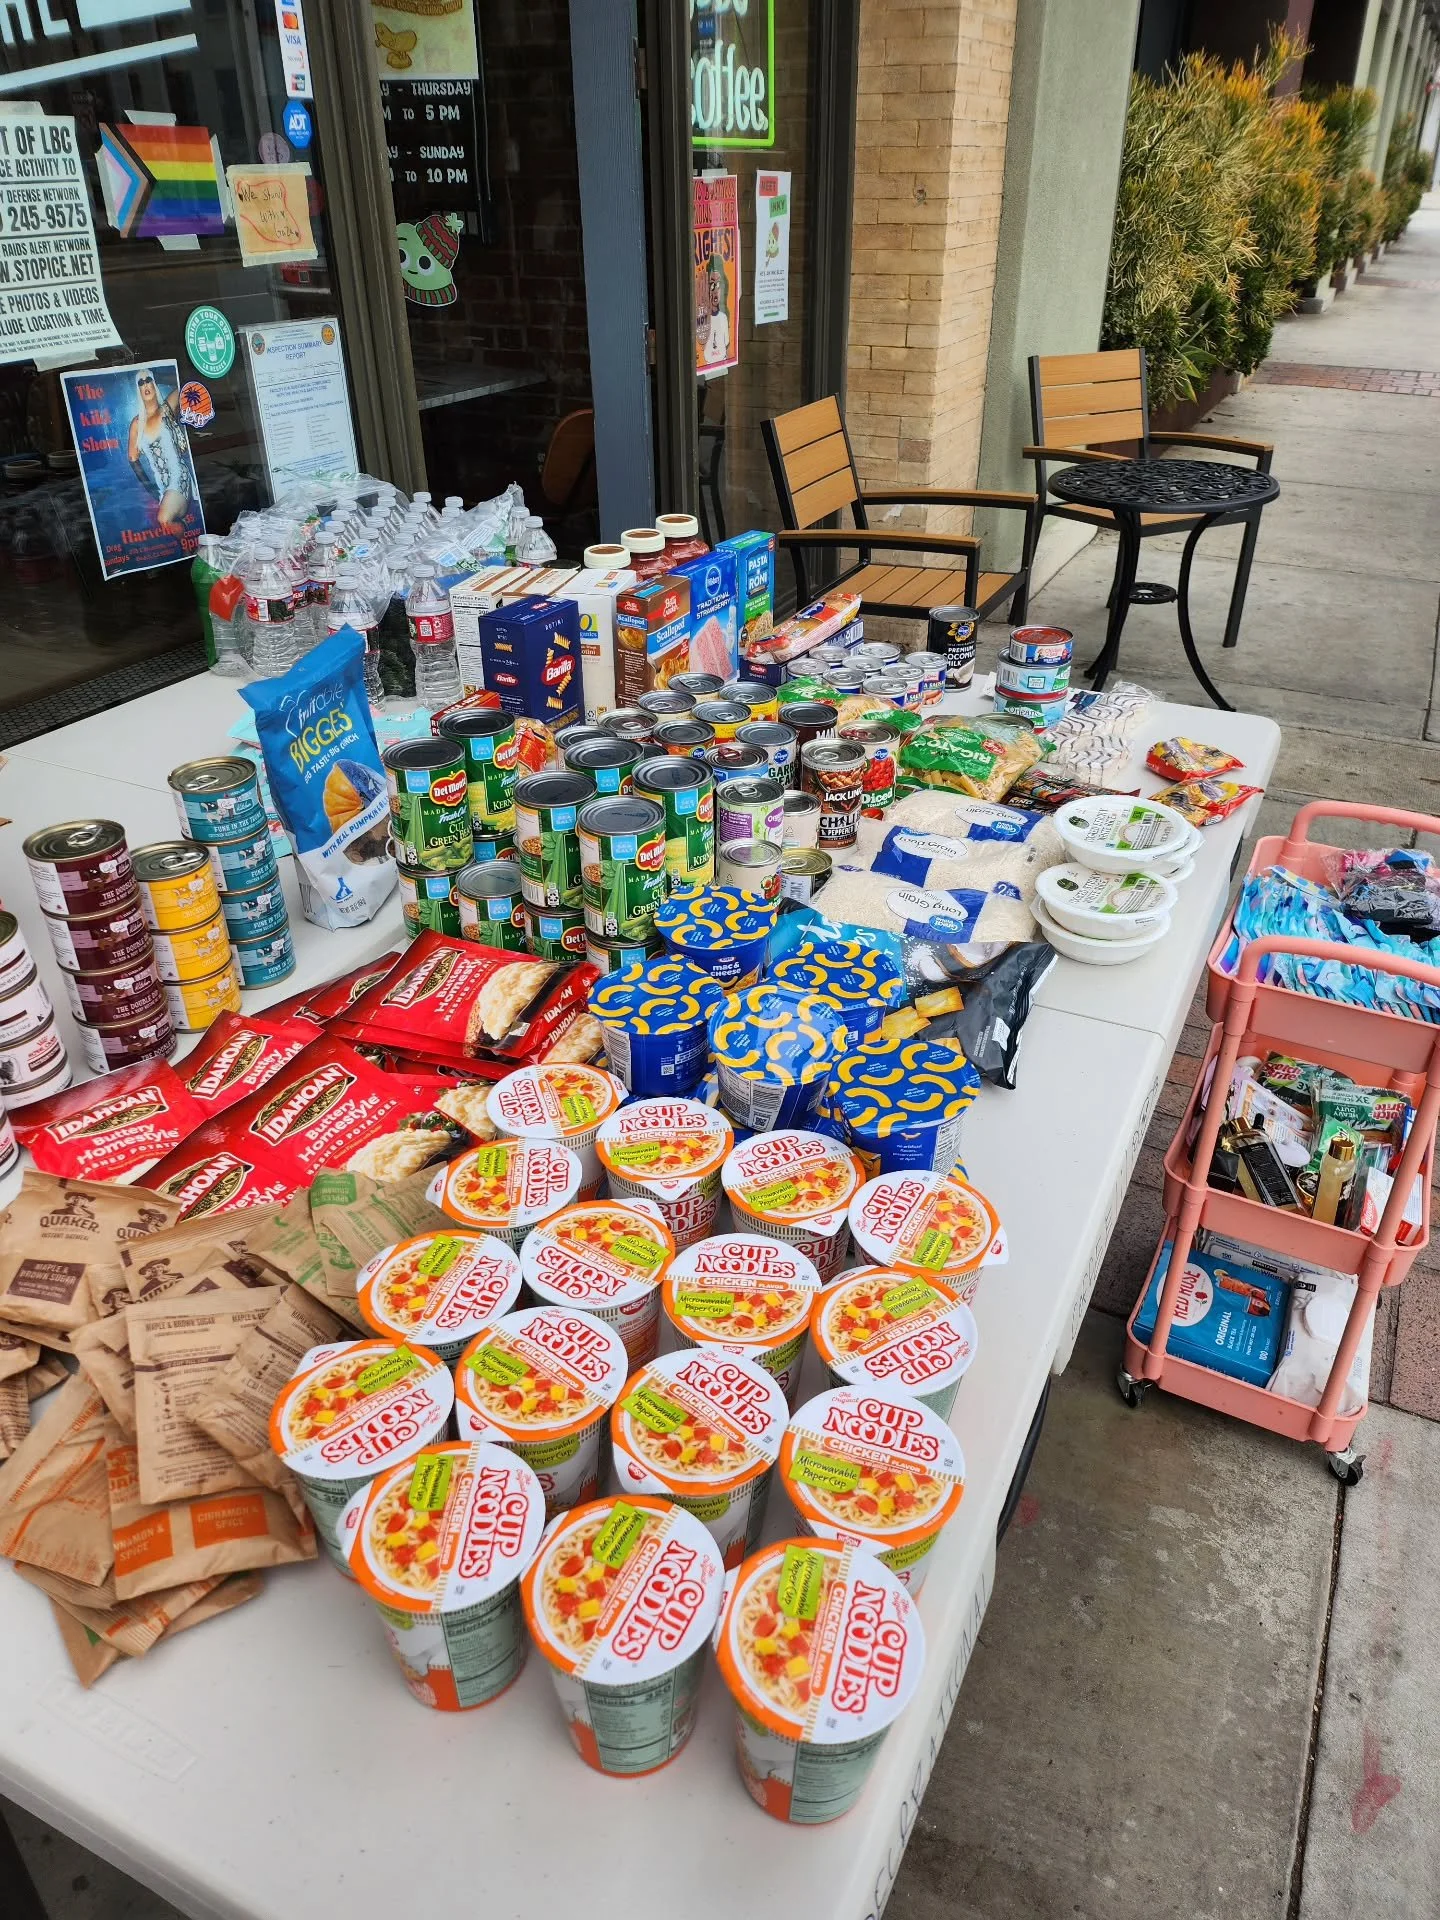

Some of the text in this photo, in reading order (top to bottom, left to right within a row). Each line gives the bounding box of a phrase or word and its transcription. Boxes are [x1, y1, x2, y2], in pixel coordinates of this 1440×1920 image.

[285, 34, 302, 46] VISA
[411, 81, 471, 96] THURSDAY
[289, 114, 307, 131] ADT
[402, 104, 461, 120] TO 5 PM
[15, 126, 72, 155] OF LBC
[419, 146, 465, 159] SUNDAY
[15, 158, 76, 178] ACTIVITY TO
[405, 168, 468, 183] TO 10 PM
[6, 187, 80, 203] DEFENSE NETWORK
[8, 203, 87, 232] 245-9575
[2, 238, 91, 257] RAIDS ALERT NETWORK
[8, 287, 100, 313] PHOTOS & VIDEOS
[26, 308, 107, 332] LOCATION & TIME
[201, 311, 218, 321] YOUR
[285, 352, 306, 361] REPORT
[298, 340, 323, 350] SUMMARY
[75, 384, 104, 400] The
[748, 555, 768, 570] PASTA
[749, 572, 768, 590] RONI
[696, 599, 731, 620] STRAWBERRY
[697, 592, 730, 610] TRADITIONAL
[617, 615, 645, 626] Scalloped
[656, 618, 685, 643] Scalloped
[948, 645, 974, 653] PREMIUM
[546, 660, 572, 682] Barilla
[434, 787, 448, 797] Del
[824, 792, 847, 801] JACK
[861, 788, 893, 805] Diced
[322, 811, 378, 859] WITH REAL PUMPKIN
[449, 821, 465, 834] CUT
[430, 834, 459, 847] GREEN
[898, 835, 957, 855] Long Grain
[640, 851, 650, 862] Del
[633, 901, 660, 916] GREEN
[898, 891, 963, 917] Long Grain
[566, 935, 580, 945] Del
[112, 948, 126, 959] THE
[394, 948, 448, 1003] IDAHOAN
[436, 957, 471, 999] Buttery
[712, 962, 740, 972] mac &
[115, 1004, 129, 1014] THE
[130, 996, 151, 1011] DOUBLE
[196, 1030, 254, 1096] IDAHOAN
[242, 1049, 283, 1086] Buttery
[56, 1088, 159, 1140] IDAHOAN
[262, 1067, 340, 1141] IDAHOAN
[1335, 1105, 1357, 1113] DUTY
[1335, 1110, 1359, 1119] HEAVY
[298, 1094, 379, 1163] Homestyle
[305, 1097, 356, 1140] Buttery
[77, 1130, 177, 1165] Homestyle
[92, 1123, 155, 1147] Buttery
[306, 1099, 397, 1176] MASHED POTATOES
[862, 1184, 899, 1220] CUP
[872, 1179, 925, 1243] NOODLES
[722, 1243, 779, 1261] CUP
[18, 1269, 77, 1286] BROWN SUGAR
[35, 1263, 60, 1272] MAPLE
[535, 1246, 627, 1297] NOODLES
[696, 1254, 797, 1279] NOODLES
[435, 1254, 503, 1329] NOODLES
[538, 1267, 591, 1298] CUP
[469, 1274, 510, 1320] CUP
[145, 1321, 165, 1332] MAPLE
[173, 1319, 195, 1329] BROWN
[197, 1317, 216, 1327] SUGAR
[558, 1317, 612, 1353] CUP
[1215, 1311, 1232, 1345] ORIGINAL
[520, 1317, 611, 1382] NOODLES
[864, 1322, 960, 1378] NOODLES
[900, 1350, 953, 1385] CUP
[716, 1364, 771, 1402] CUP
[672, 1384, 720, 1423] CHICKEN
[677, 1359, 777, 1435] NOODLES
[319, 1388, 434, 1463] NOODLES
[857, 1397, 923, 1430] CUP
[357, 1420, 420, 1466] CUP
[823, 1407, 942, 1461] NOODLES
[829, 1438, 890, 1463] CHICKEN
[198, 1507, 249, 1524] CINNAMON
[450, 1475, 471, 1536] CHICKEN
[215, 1518, 245, 1530] SPICE
[458, 1467, 510, 1580] NOODLES
[490, 1491, 528, 1557] CUP
[119, 1541, 150, 1562] SPICE
[618, 1541, 660, 1605] CHICKEN
[611, 1539, 698, 1661] NOODLES
[654, 1578, 705, 1651] CUP
[820, 1585, 846, 1653] CHICKEN
[831, 1580, 885, 1715] NOODLES
[862, 1620, 908, 1697] CUP
